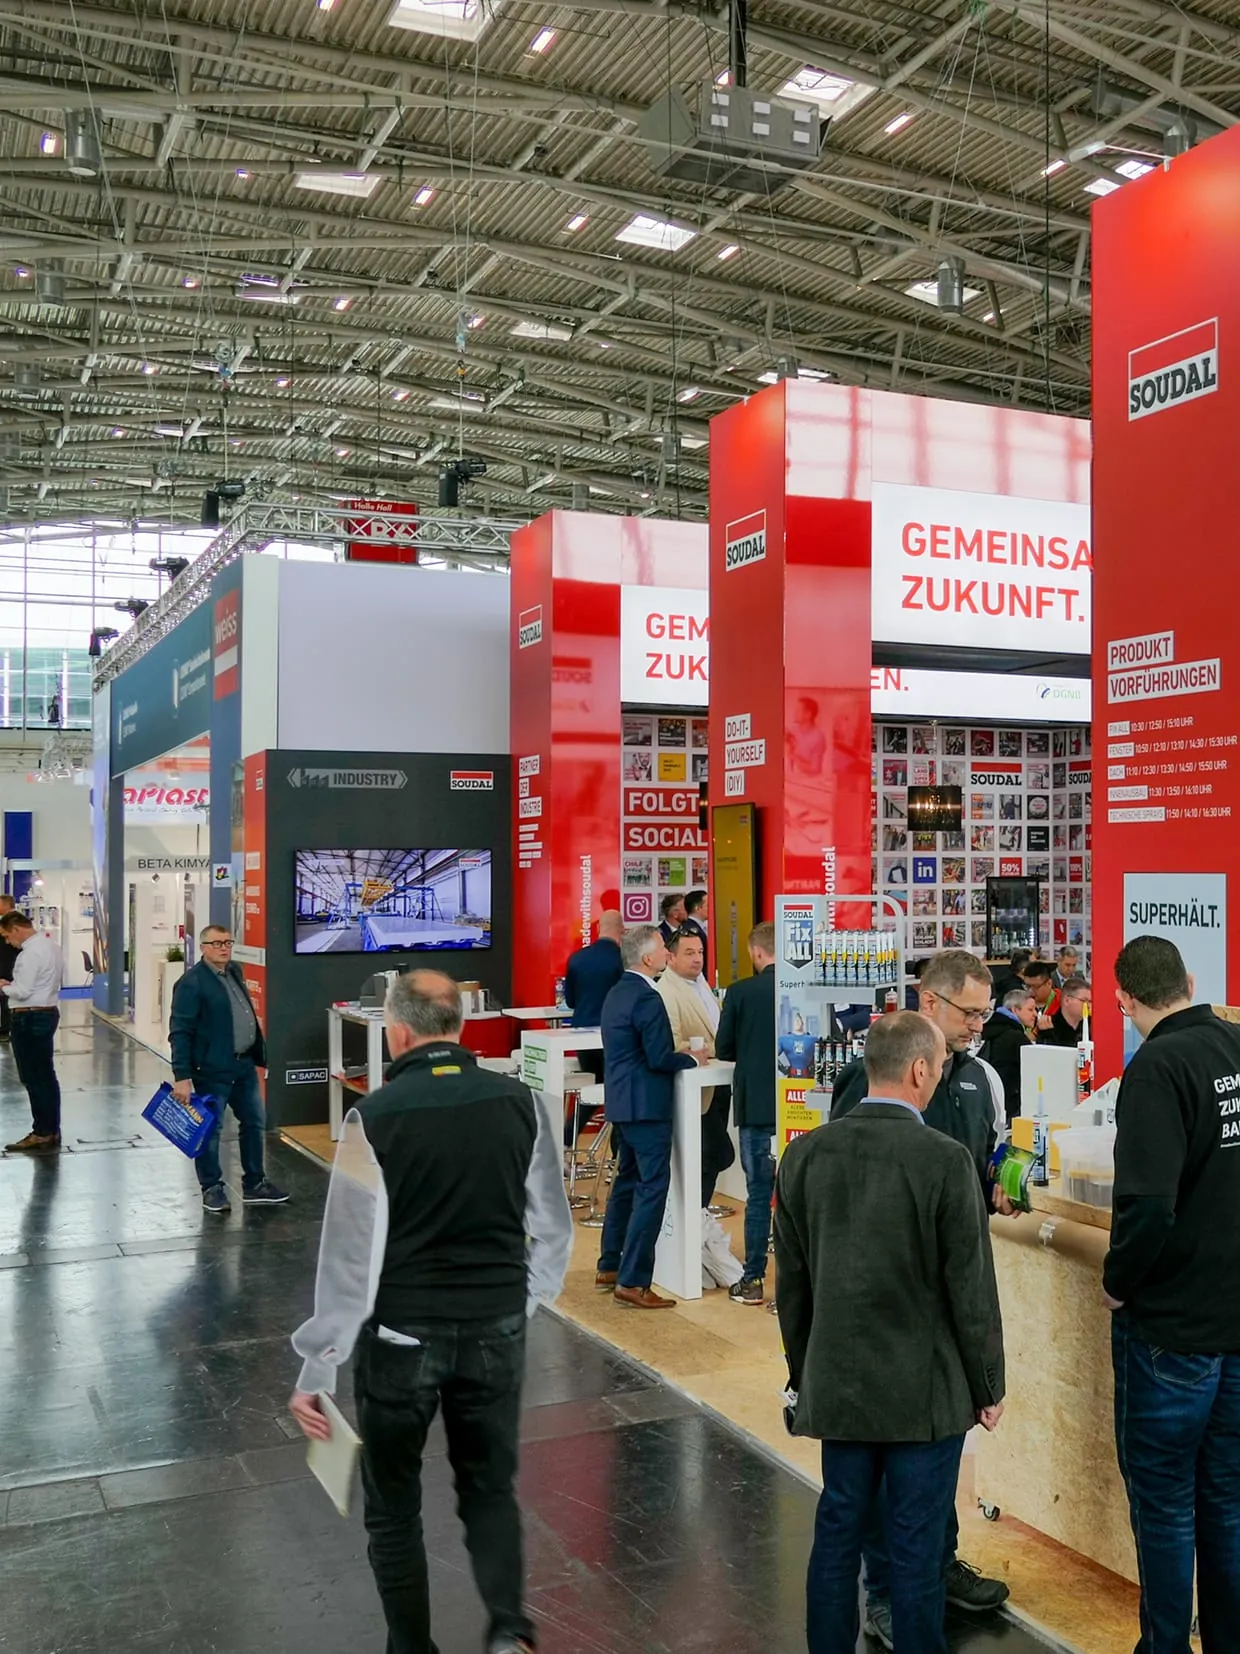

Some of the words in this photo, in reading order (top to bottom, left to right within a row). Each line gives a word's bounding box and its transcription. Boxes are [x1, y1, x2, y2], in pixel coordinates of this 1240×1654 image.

[1130, 357, 1217, 415] SOUDAL
[376, 503, 393, 511] Hall
[726, 532, 765, 568] SOUDAL
[901, 575, 1085, 622] ZUKUNFT.
[520, 623, 541, 646] SOUDAL
[1111, 637, 1171, 665] PRODUKT
[1110, 663, 1217, 698] VORFÜHRUNGEN
[727, 719, 749, 739] DO-IT-
[1180, 716, 1194, 726] UHR
[727, 744, 763, 764] YOURSELF
[1214, 760, 1227, 770] UHR
[333, 772, 398, 787] INDUSTRY
[451, 780, 492, 789] SOUDAL
[727, 774, 743, 794] (DIY)
[971, 774, 1022, 786] SOUDAL
[1199, 784, 1213, 794] UHR
[629, 792, 700, 812] FOLGT
[1218, 807, 1231, 816] UHR
[628, 827, 708, 847] SOCIAL
[138, 859, 172, 869] BETA
[1002, 864, 1019, 873] 50%
[1130, 898, 1220, 928] SUPERHÄLT.
[786, 942, 812, 960] ALL
[300, 1072, 325, 1080] SAPAC
